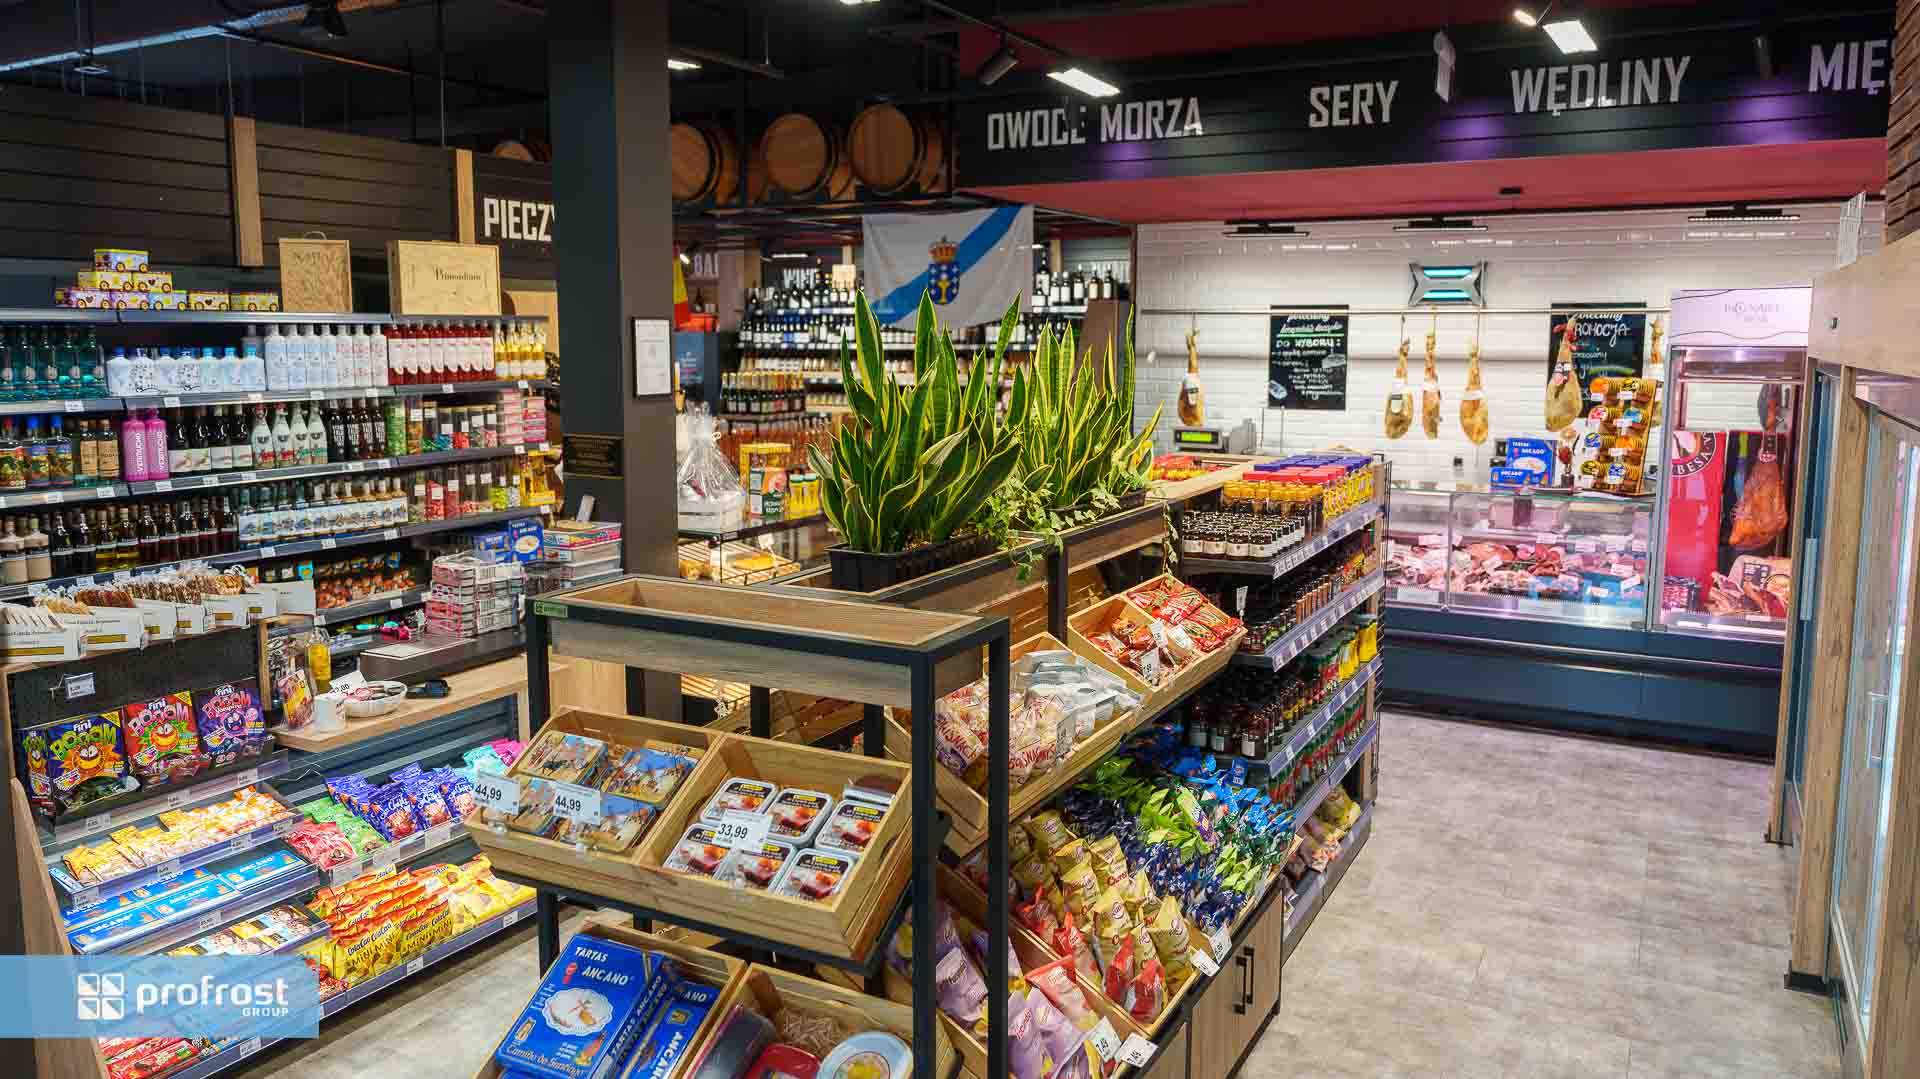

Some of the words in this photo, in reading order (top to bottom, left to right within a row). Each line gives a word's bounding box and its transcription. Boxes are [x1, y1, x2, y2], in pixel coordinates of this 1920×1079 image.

[1511, 55, 1691, 117] WĘDLINY
[1308, 79, 1399, 128] SERY
[1100, 97, 1204, 143] MORZA
[483, 197, 556, 243] PIECZ
[1574, 322, 1631, 348] ROMOCJA
[148, 698, 166, 710] fini
[73, 720, 92, 732] fini
[475, 783, 502, 801] 44,99
[555, 795, 581, 812] 44,99
[718, 823, 749, 839] 33,99
[575, 946, 608, 963] TARTAS
[581, 966, 629, 986] ANCANO
[684, 991, 708, 1003] ANO
